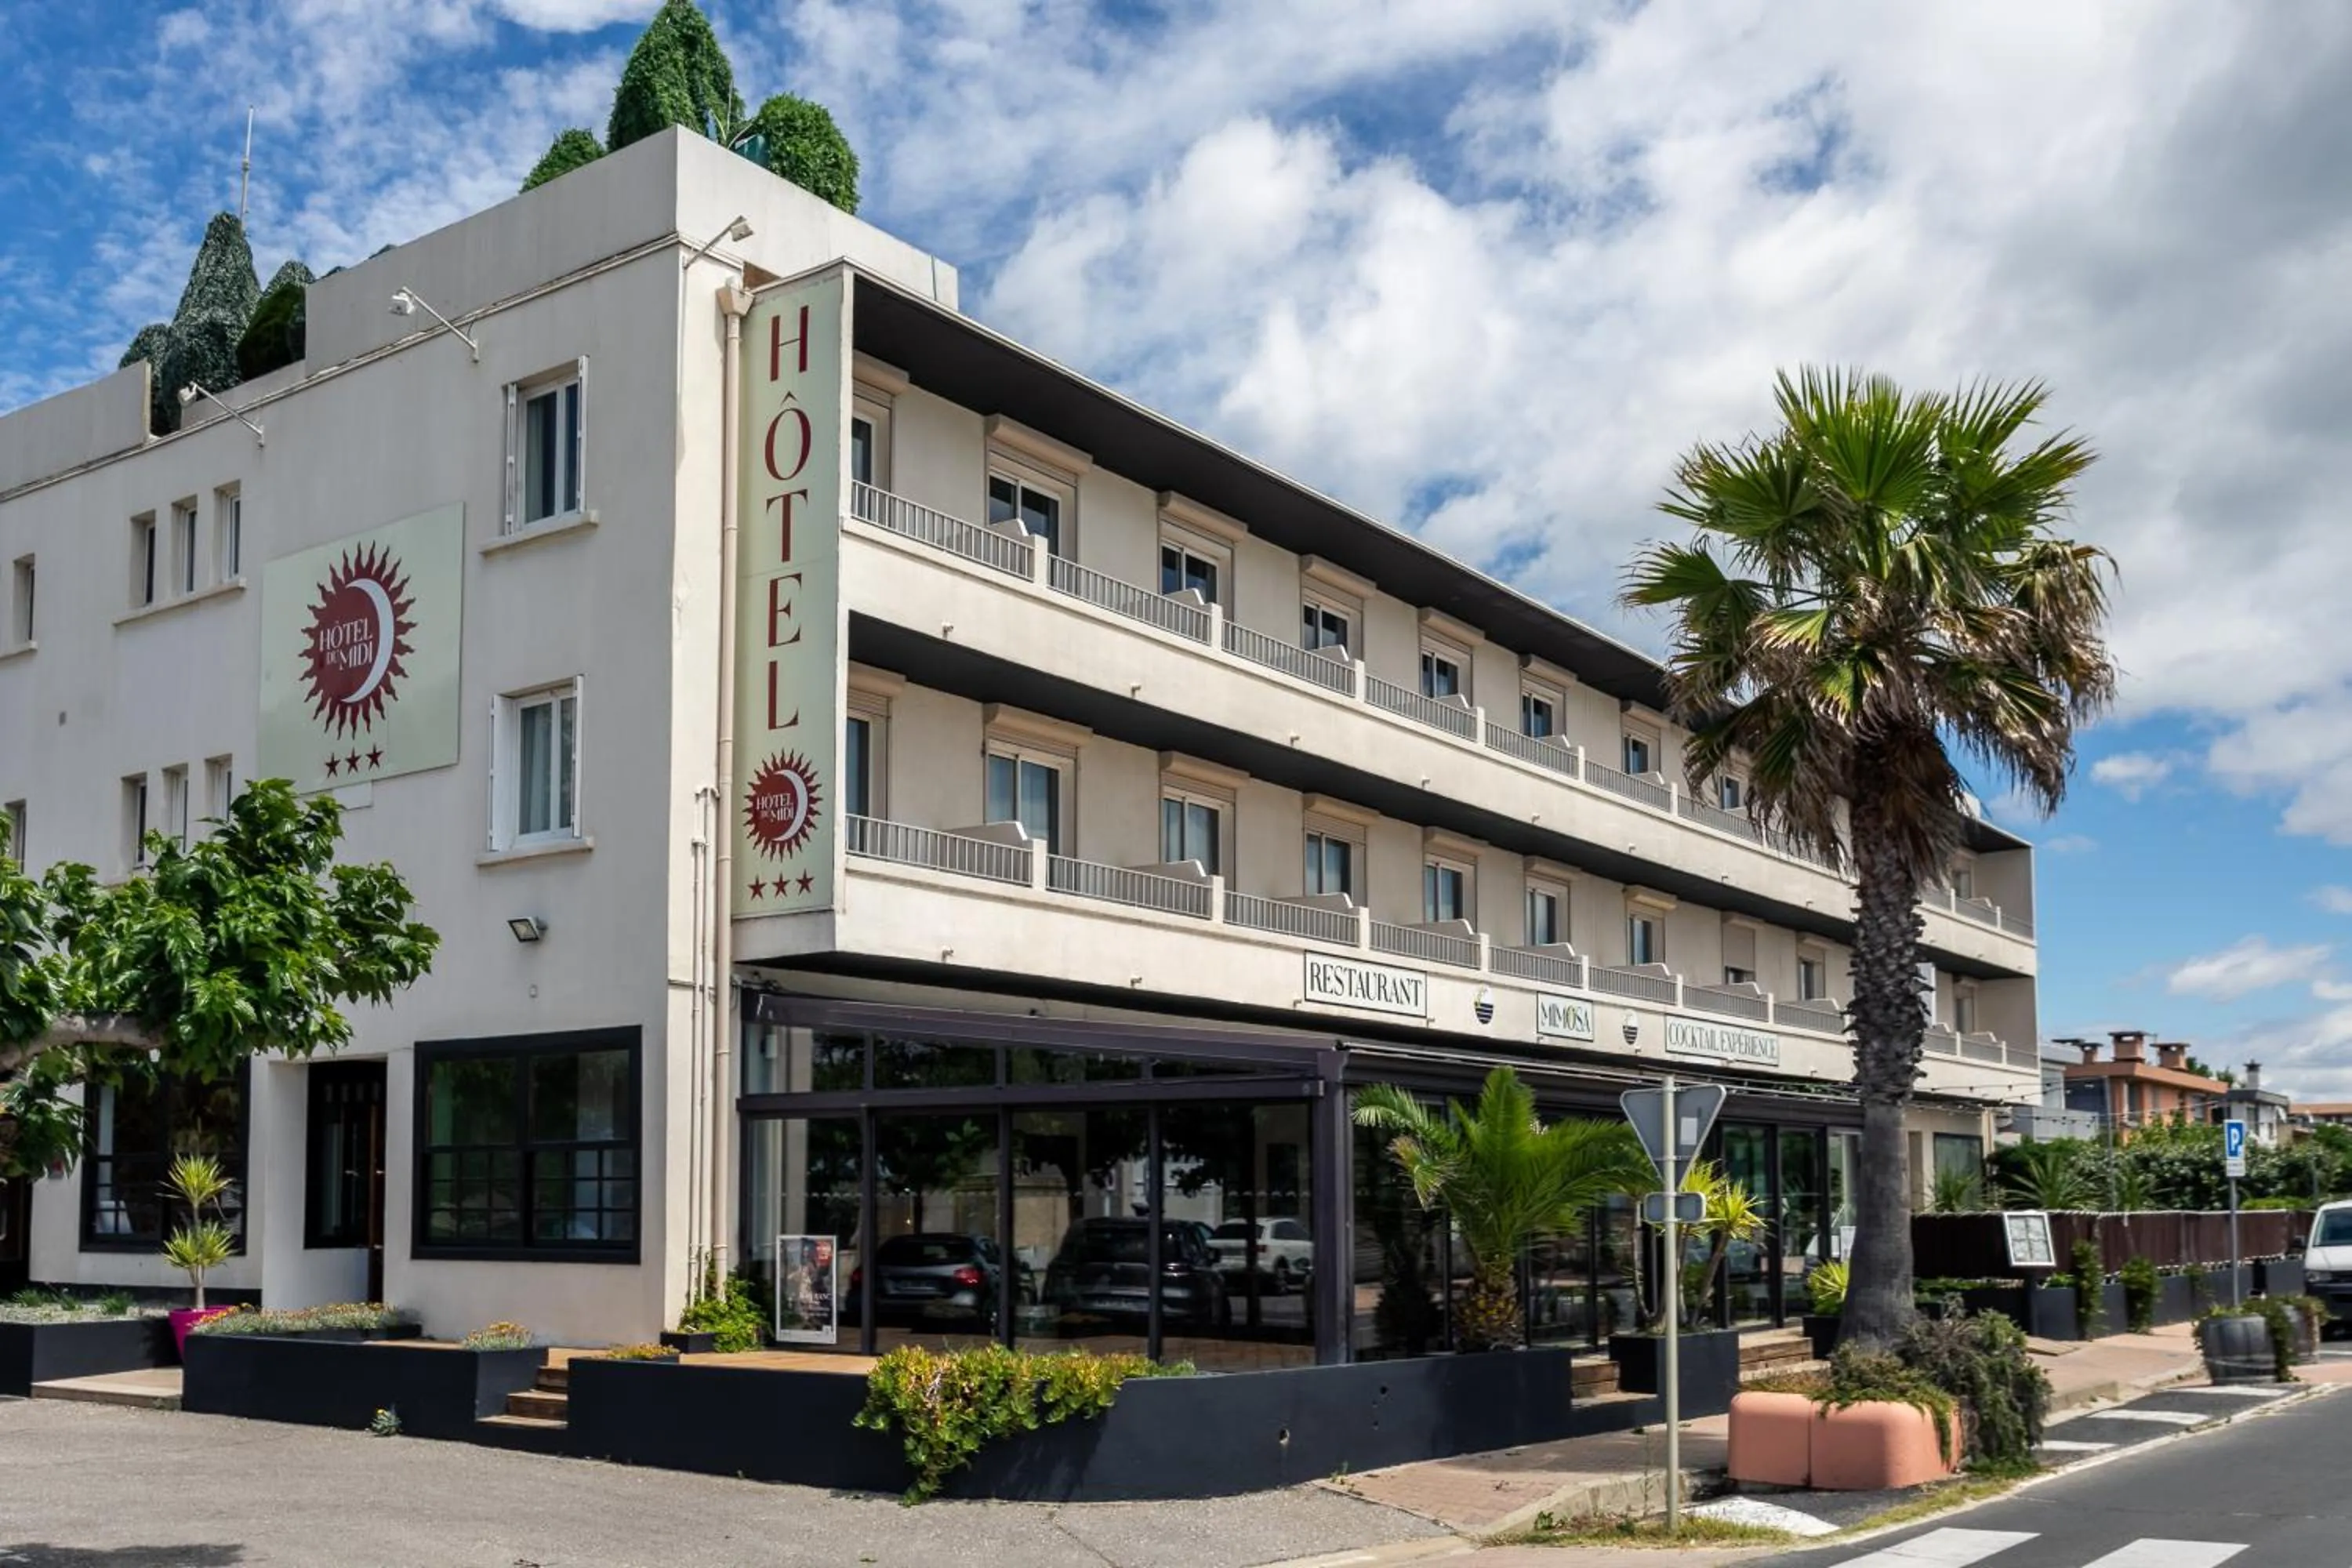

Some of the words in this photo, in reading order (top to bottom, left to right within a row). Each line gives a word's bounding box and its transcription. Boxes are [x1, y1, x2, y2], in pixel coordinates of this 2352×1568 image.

[765, 305, 811, 730] HÔTEL
[319, 619, 372, 652] HÔTEL
[326, 649, 339, 664] DU
[339, 641, 373, 670] MIDI
[757, 793, 793, 811] HÔTEL
[771, 806, 793, 822] MIDI
[1310, 962, 1424, 1007] RESTAURANT
[1541, 1001, 1591, 1033] MIMOSA
[1668, 1022, 1719, 1051] COCKTAIL
[1720, 1029, 1778, 1059] EXPÉRIENCE
[2230, 1128, 2240, 1151] P
